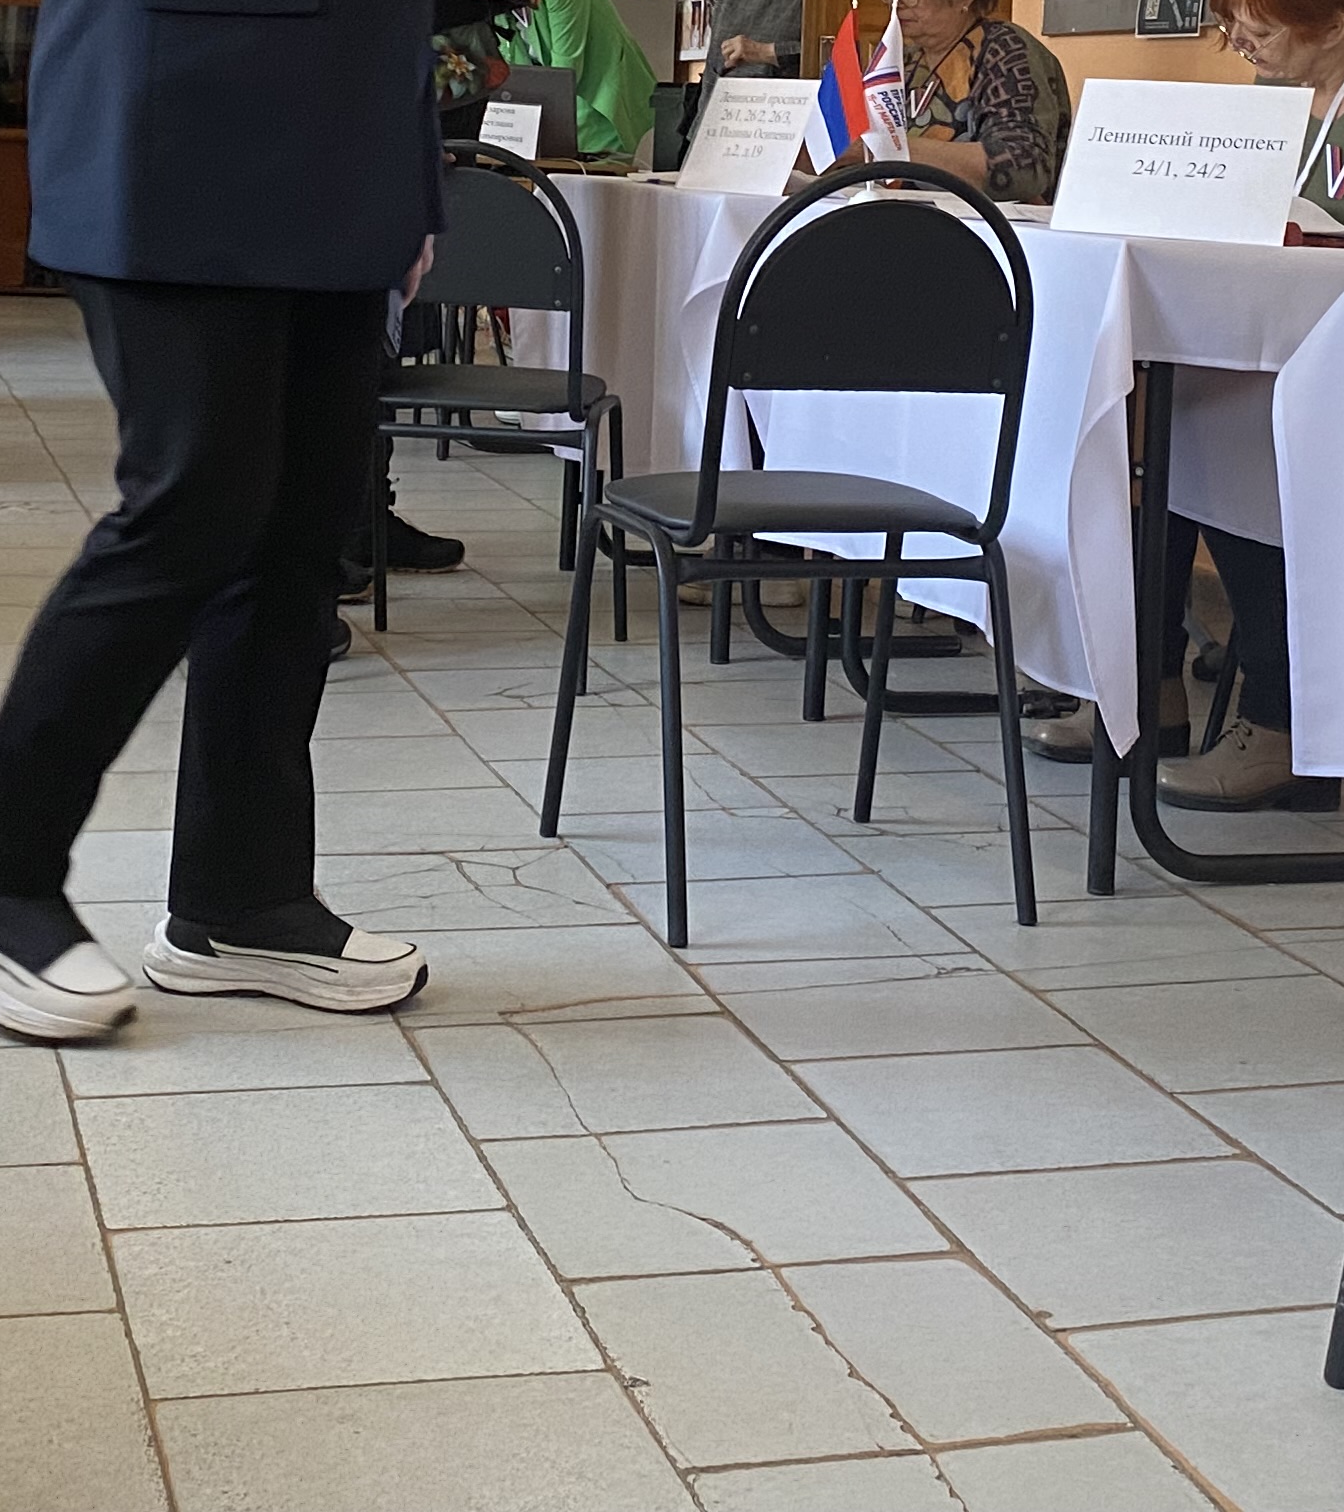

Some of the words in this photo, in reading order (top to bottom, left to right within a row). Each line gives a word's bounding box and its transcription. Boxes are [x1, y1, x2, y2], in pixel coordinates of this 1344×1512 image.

[1088, 126, 1193, 147] Ленинский
[1199, 137, 1288, 152] проспект
[1131, 159, 1179, 180] 24/1,
[1184, 162, 1227, 179] 24/2
